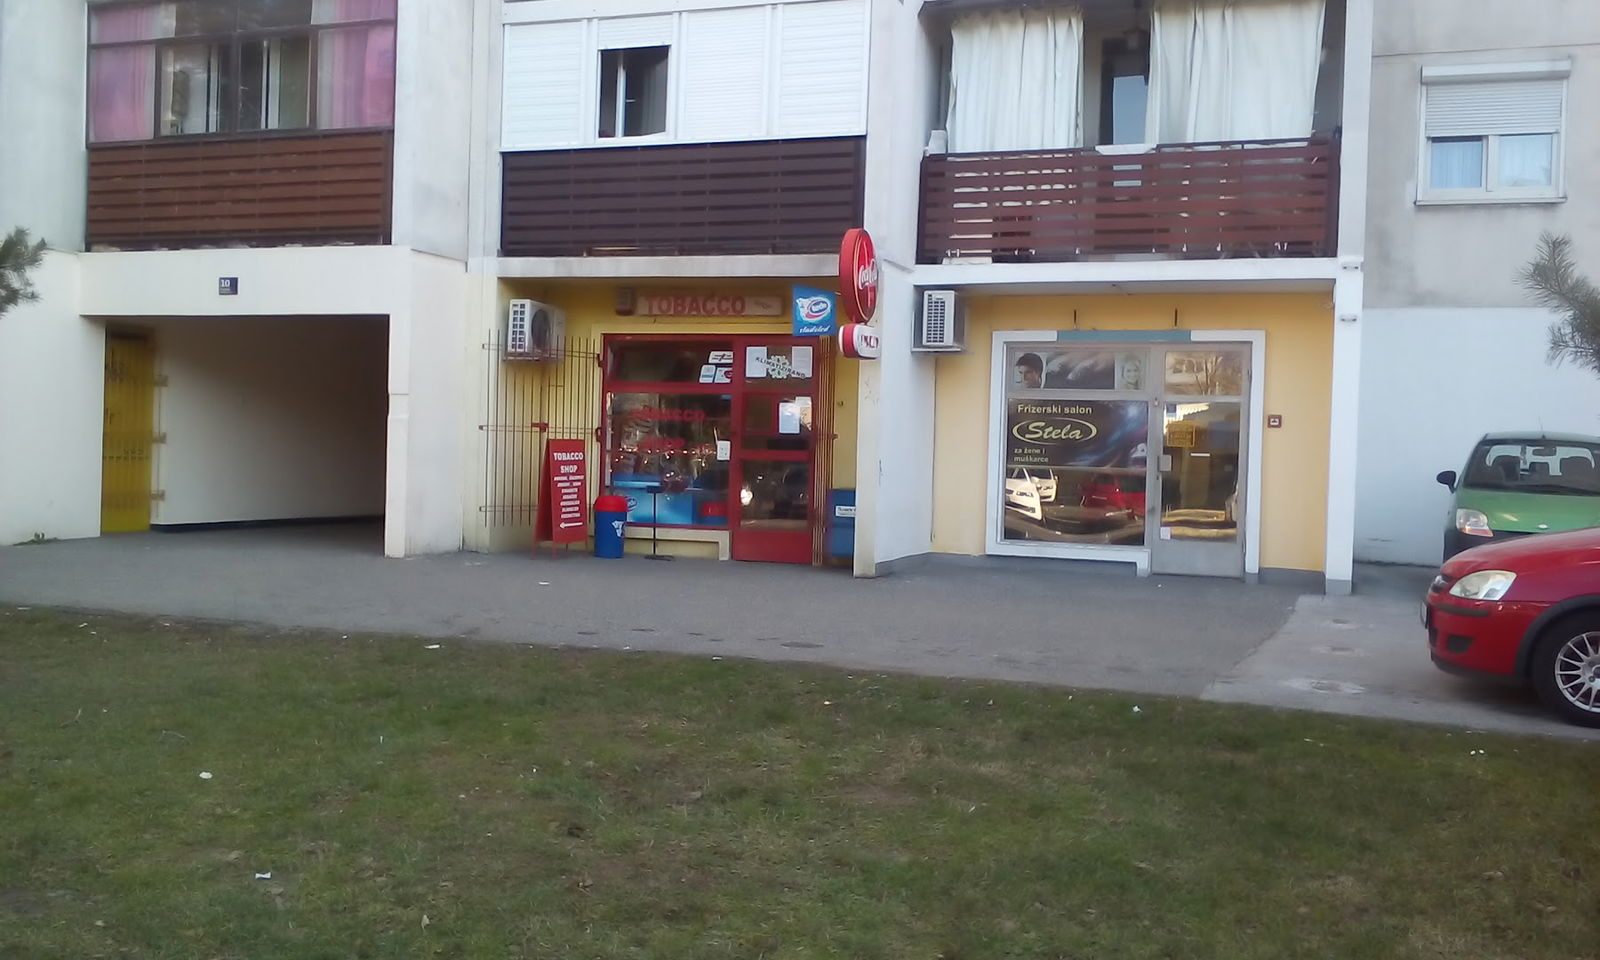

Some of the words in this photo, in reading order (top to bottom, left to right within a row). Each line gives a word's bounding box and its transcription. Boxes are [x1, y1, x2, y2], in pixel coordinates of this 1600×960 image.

[221, 279, 231, 288] 10
[645, 295, 746, 314] TOBACCO
[1017, 404, 1061, 414] Frizerski
[1063, 405, 1092, 414] salon
[1025, 421, 1084, 440] Stela
[553, 452, 584, 461] TOBACCO
[560, 464, 578, 474] SHOP
